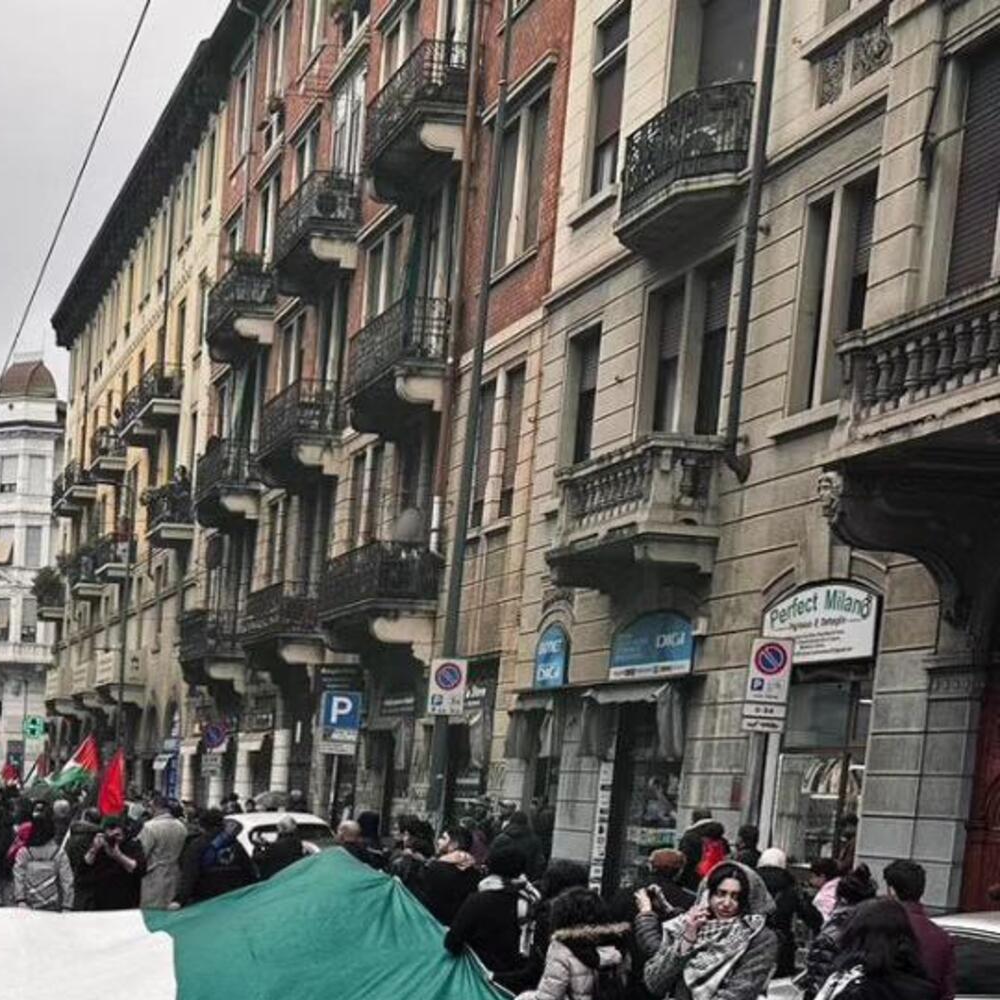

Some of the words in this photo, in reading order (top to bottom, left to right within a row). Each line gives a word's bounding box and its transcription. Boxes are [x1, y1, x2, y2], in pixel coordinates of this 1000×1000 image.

[770, 592, 818, 627] Perfect
[655, 631, 686, 649] DIGI
[536, 664, 561, 681] DIGI
[331, 696, 353, 724] P
